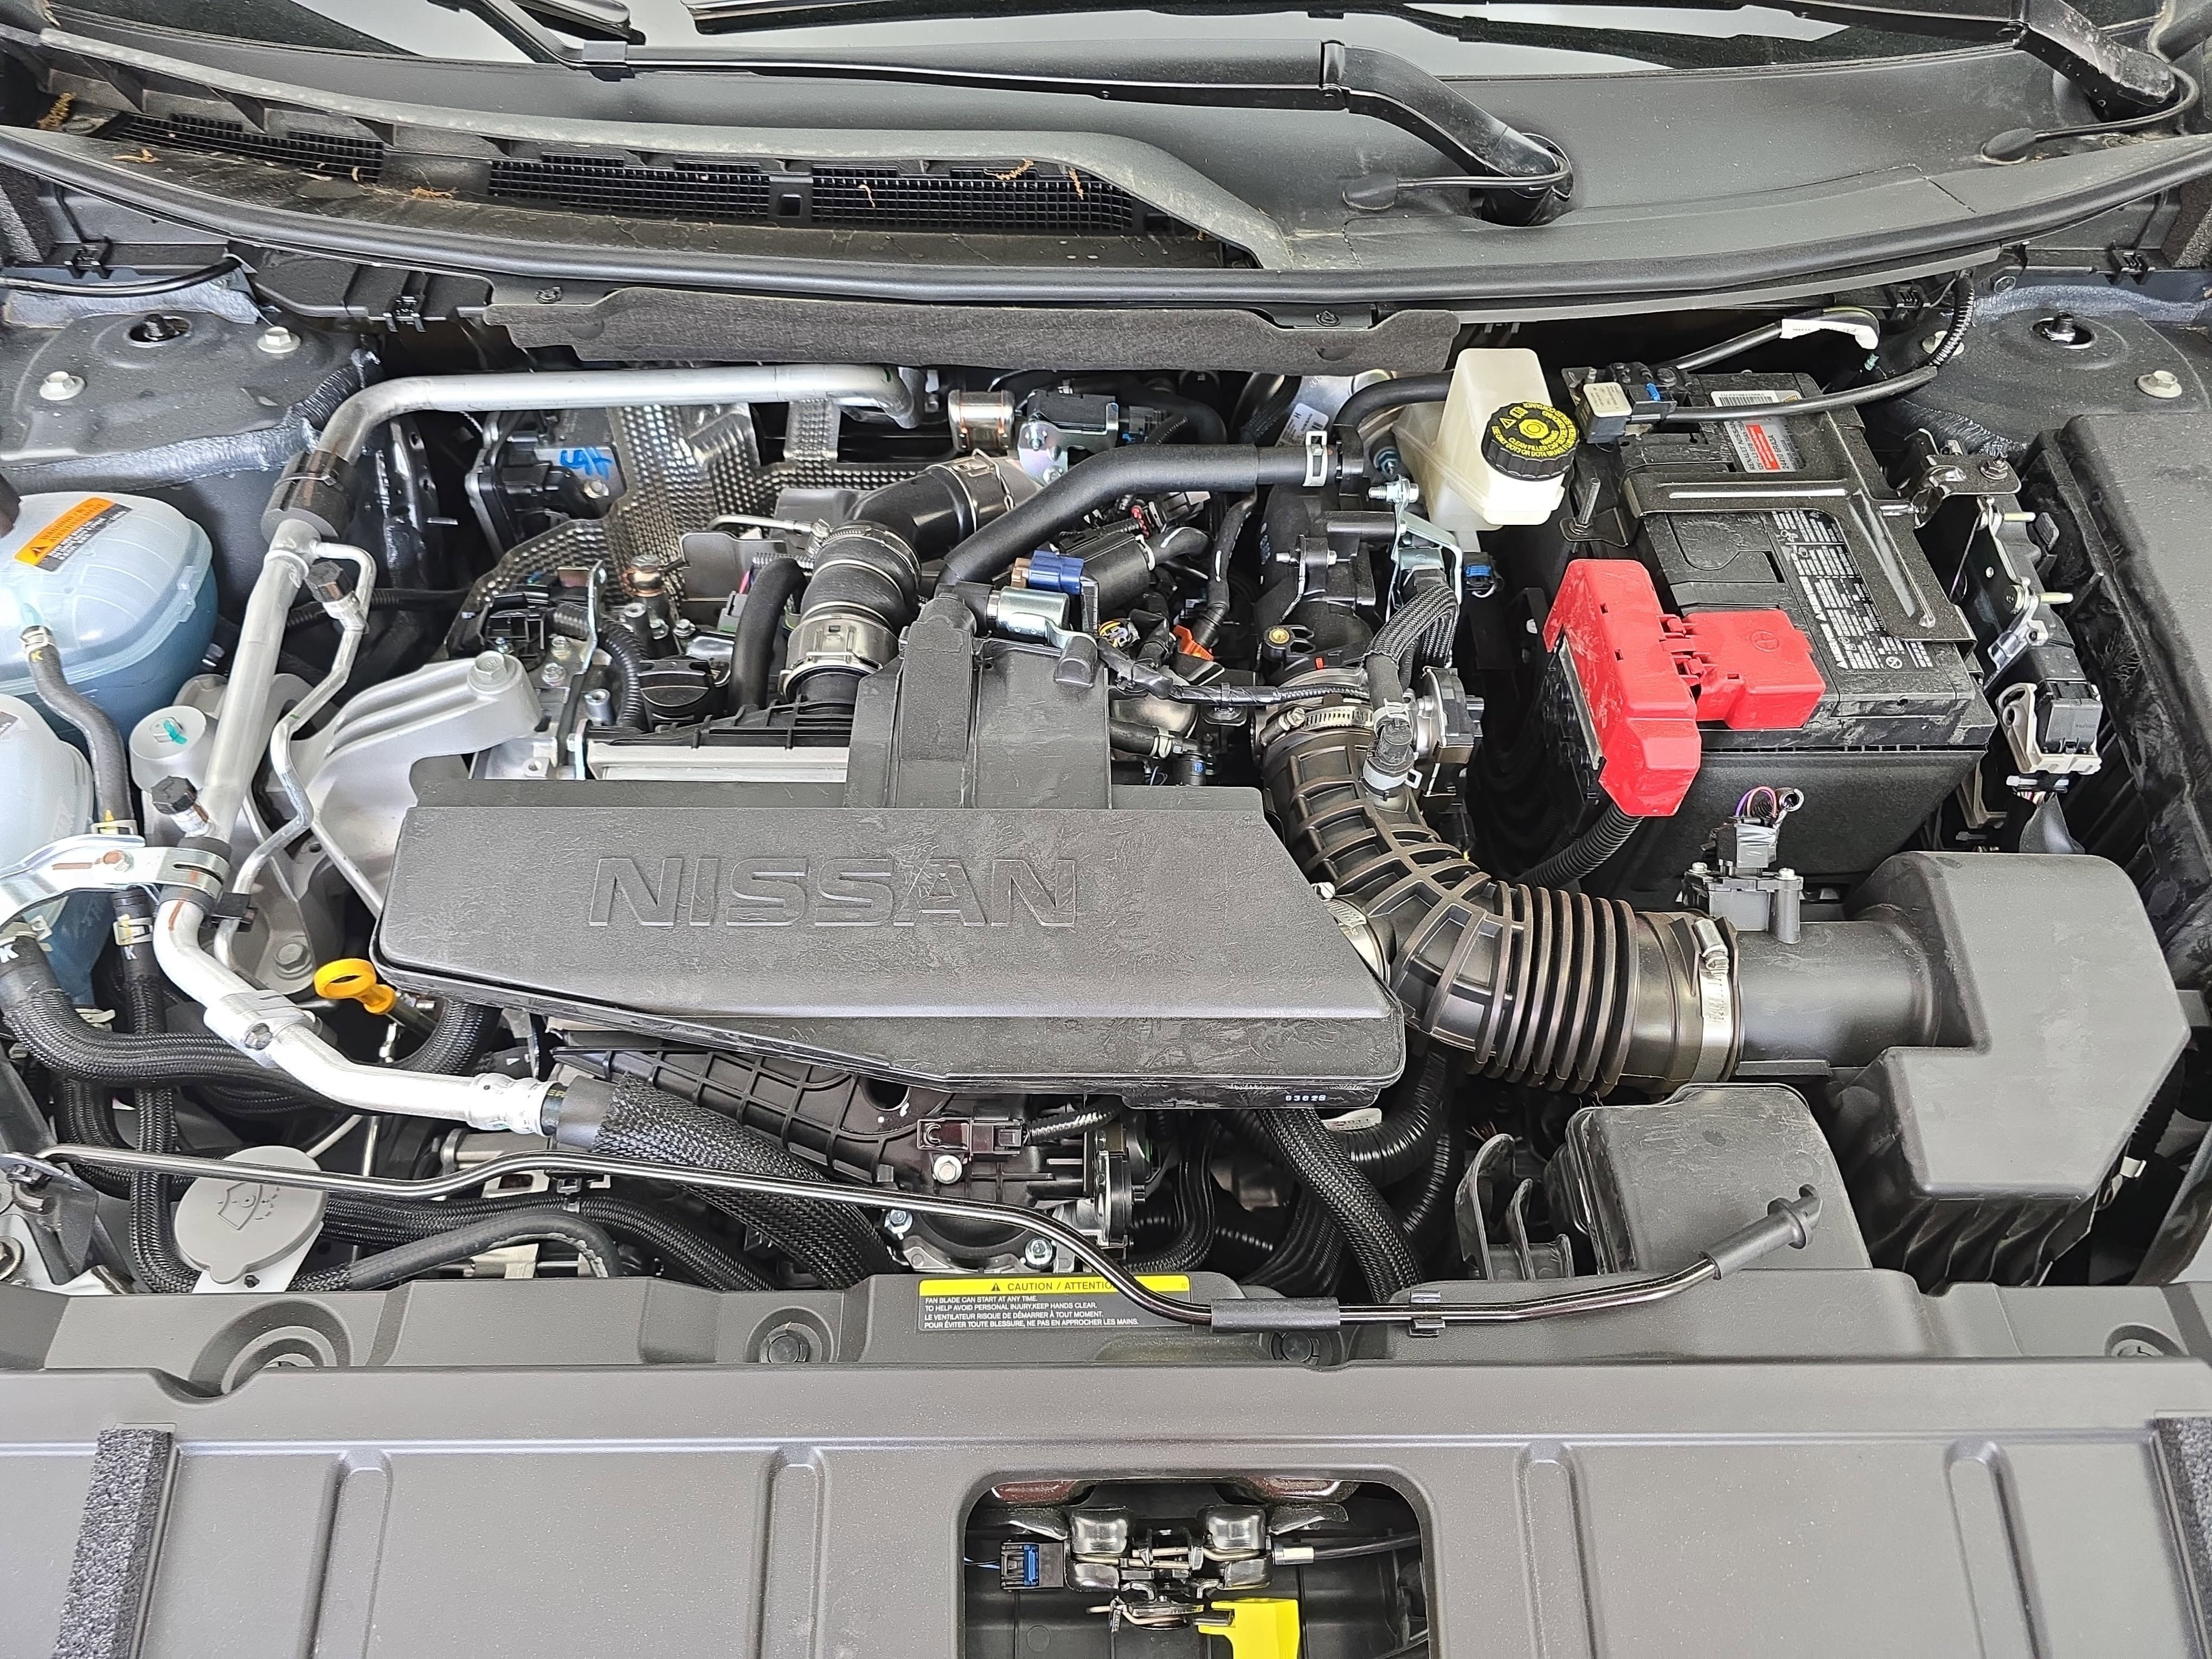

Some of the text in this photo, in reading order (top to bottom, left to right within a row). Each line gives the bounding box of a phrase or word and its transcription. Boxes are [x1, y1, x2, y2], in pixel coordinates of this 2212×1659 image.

[1508, 437, 1528, 449] CLEAN
[1729, 421, 1756, 470] RENAULT NISSAN
[1547, 447, 1566, 456] BRAKE
[588, 858, 1076, 927] NISSAN
[124, 945, 138, 960] K
[1008, 1282, 1052, 1291] CAUTION
[1065, 1281, 1115, 1290] ATTENTIO
